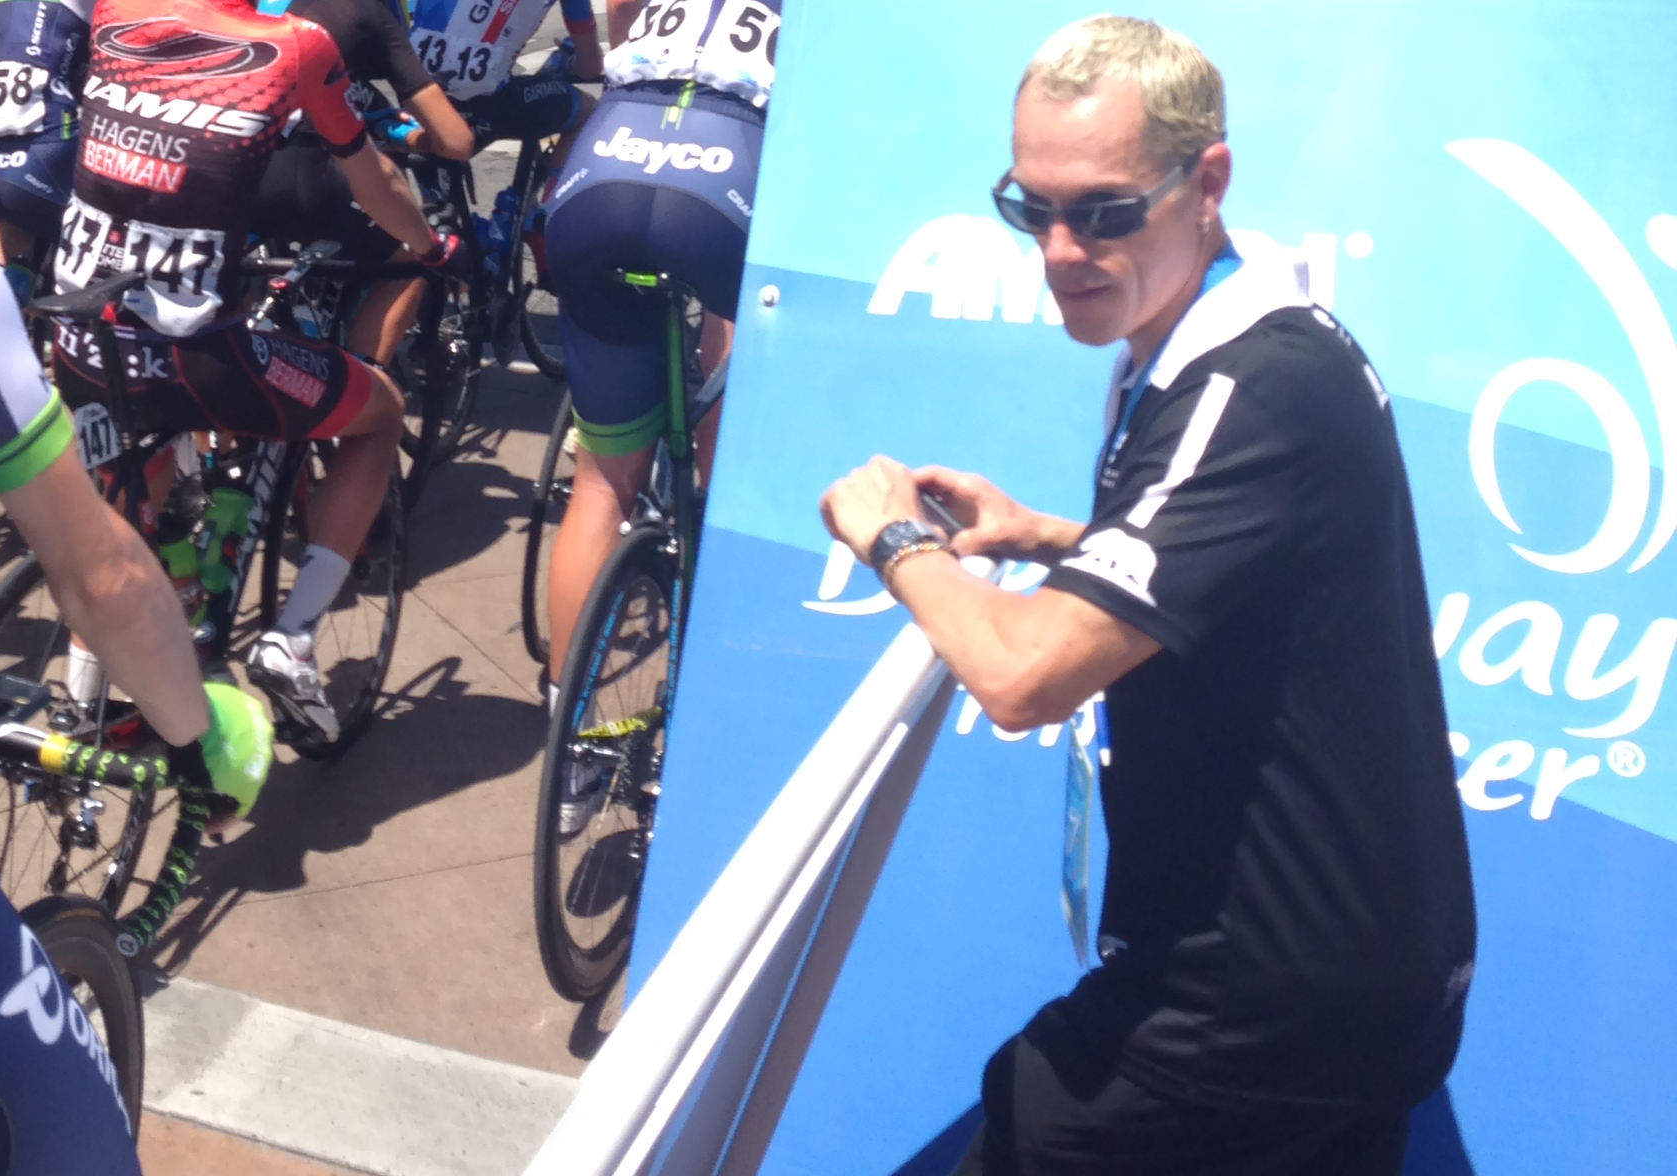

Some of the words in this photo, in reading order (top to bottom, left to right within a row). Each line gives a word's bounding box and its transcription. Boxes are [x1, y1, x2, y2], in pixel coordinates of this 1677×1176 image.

[456, 46, 492, 82] 13
[92, 114, 191, 163] HAGENS
[593, 127, 734, 174] Jayco
[84, 138, 187, 193] BERMAN
[128, 231, 224, 296] 147
[270, 337, 330, 382] HAGENS
